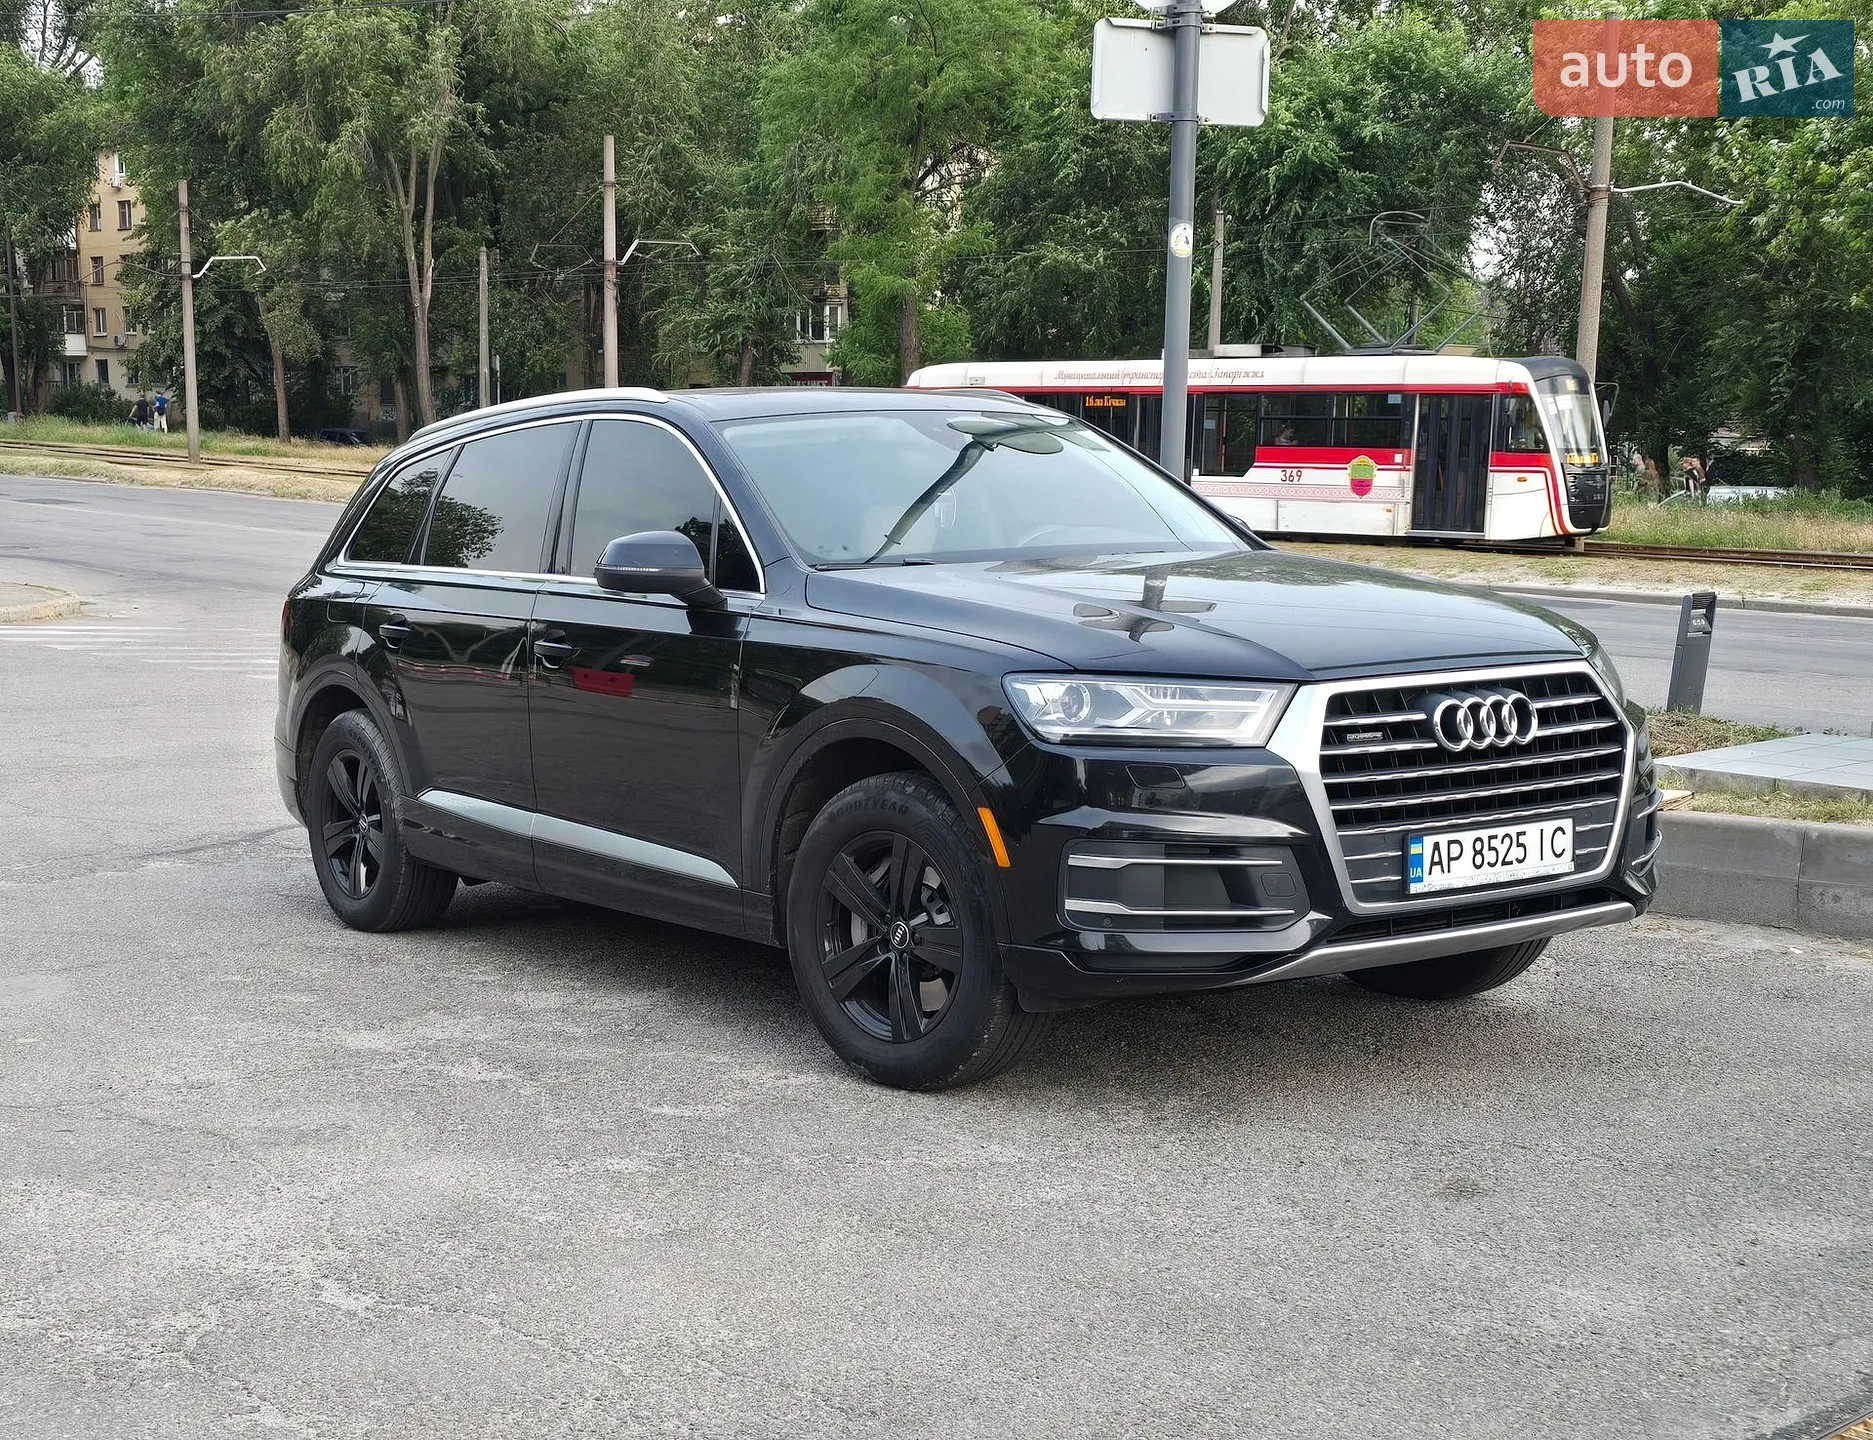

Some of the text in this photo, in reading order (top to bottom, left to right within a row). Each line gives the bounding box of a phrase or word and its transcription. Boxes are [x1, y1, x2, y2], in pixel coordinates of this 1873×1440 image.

[1120, 368, 1164, 385] транспор
[1189, 370, 1207, 379] ста
[1281, 469, 1303, 482] 369
[1428, 826, 1566, 876] AP 8525 IC
[1410, 867, 1423, 879] UA
